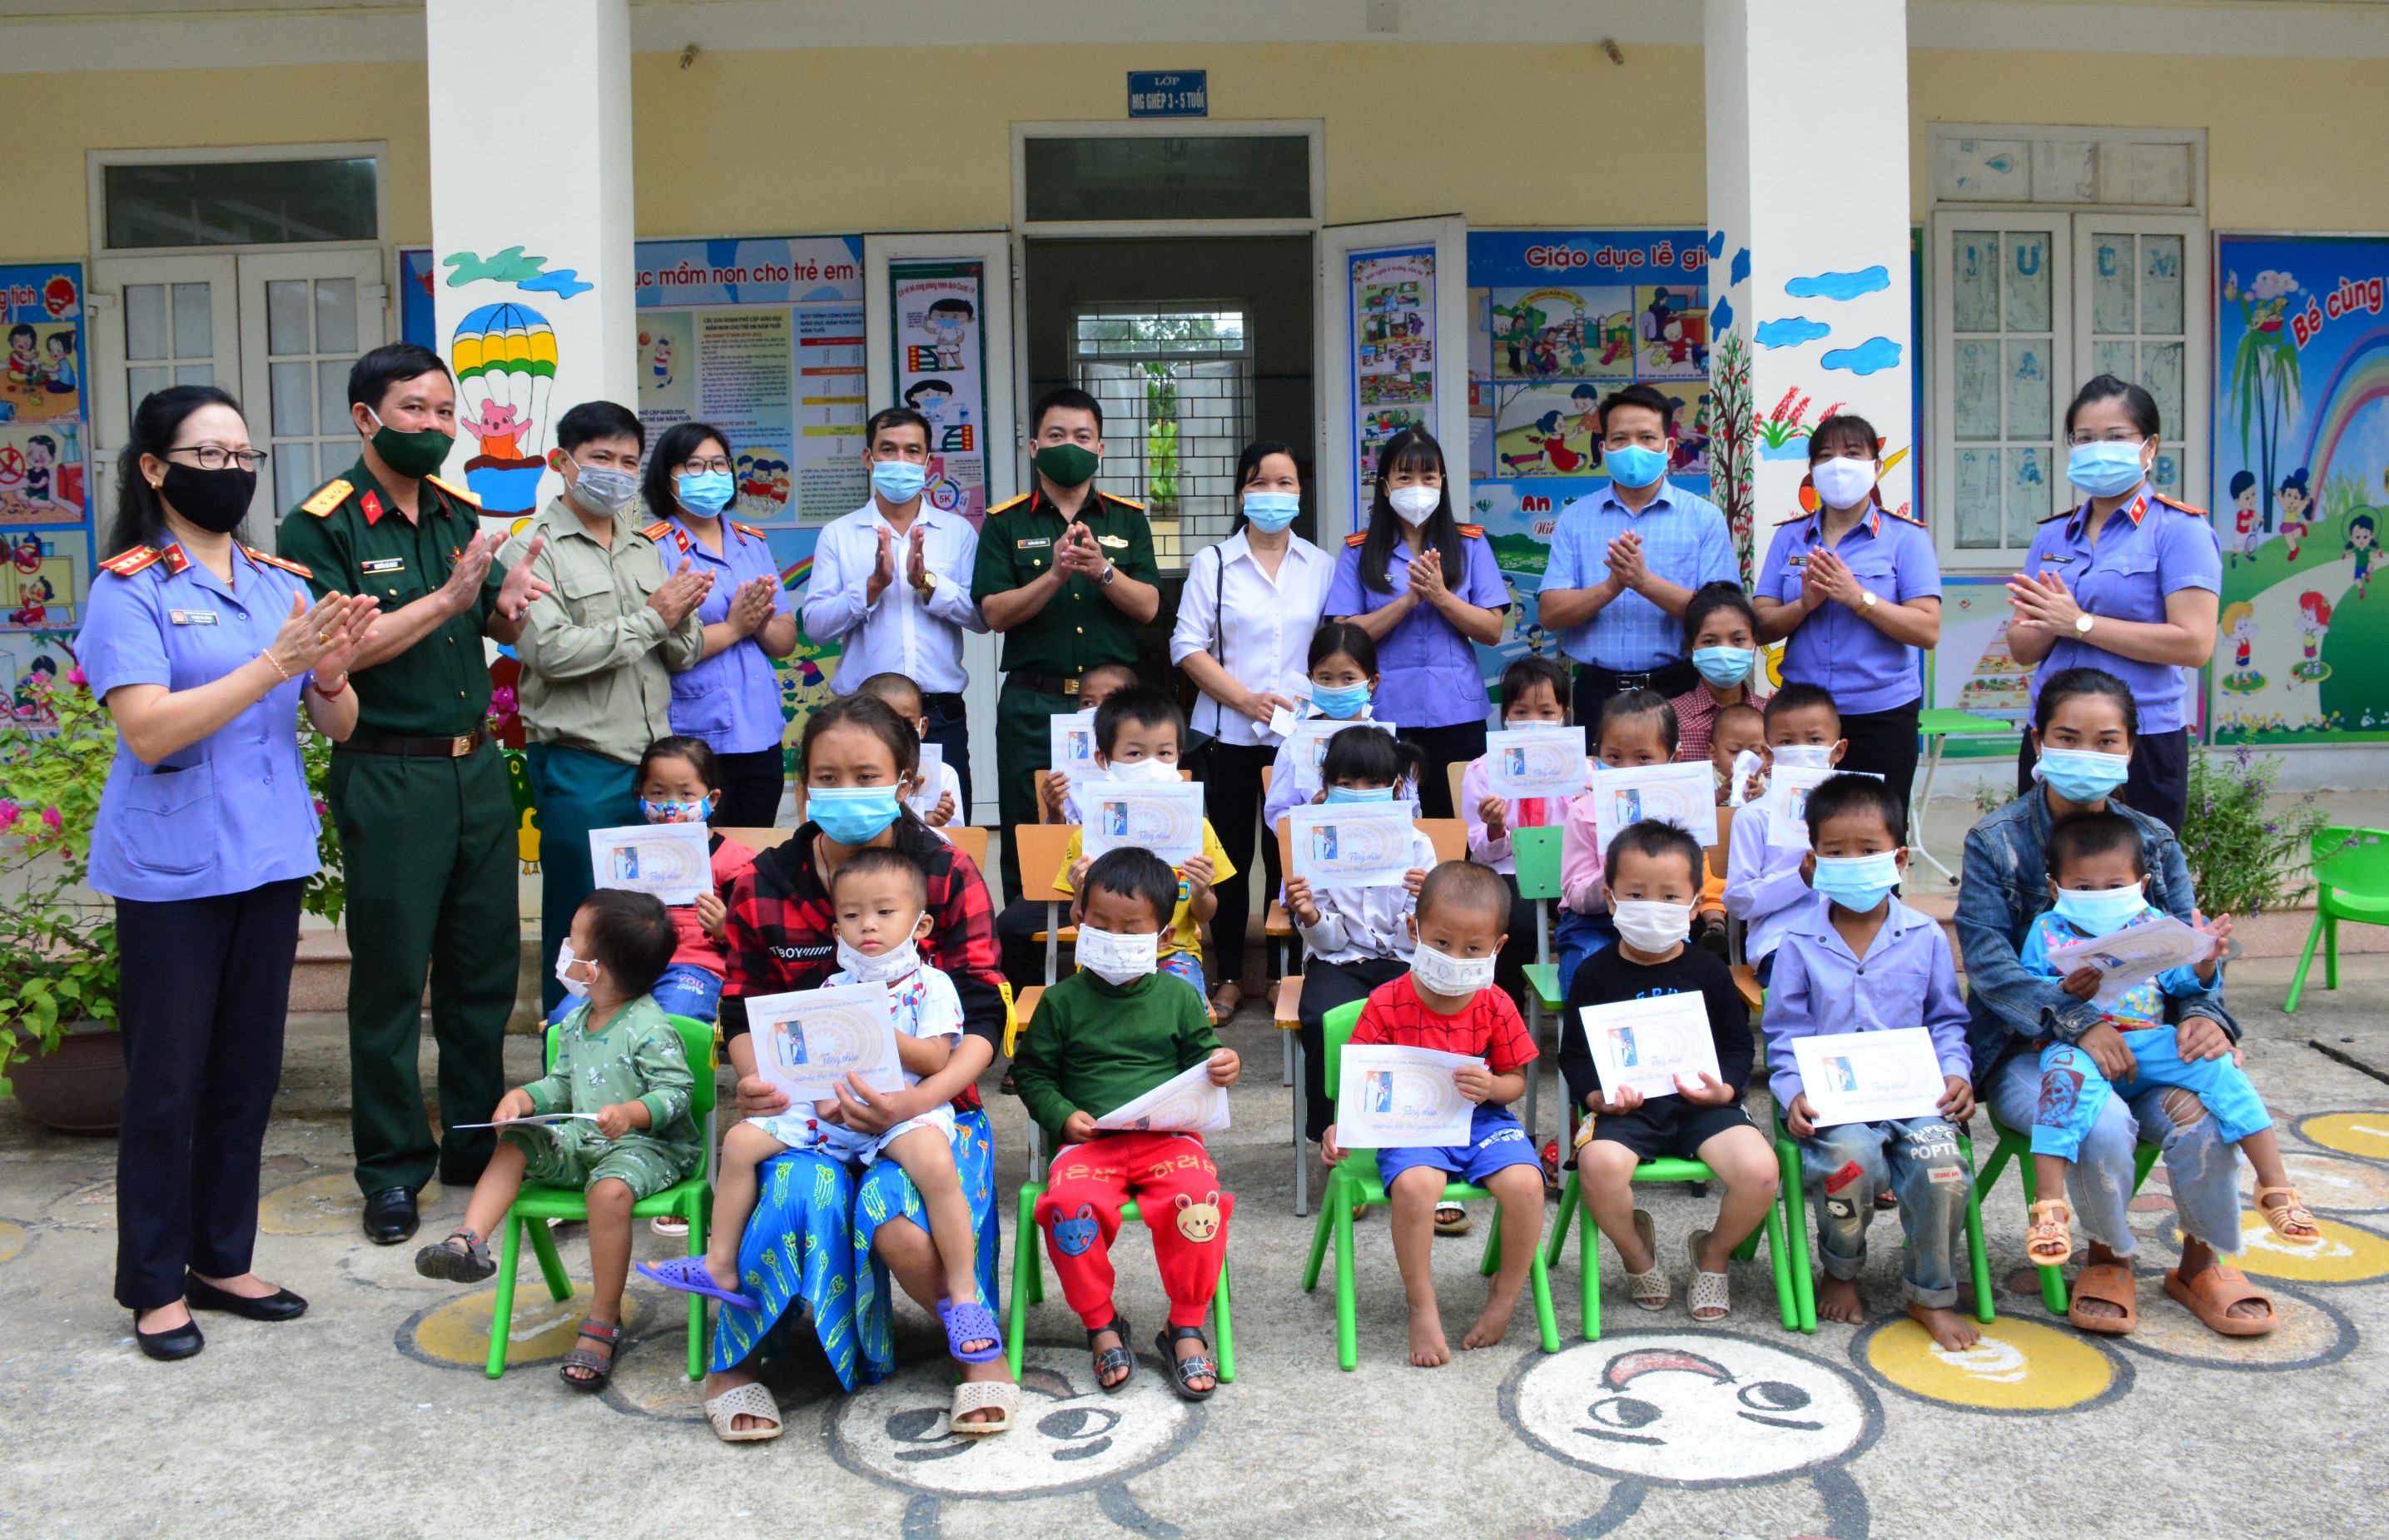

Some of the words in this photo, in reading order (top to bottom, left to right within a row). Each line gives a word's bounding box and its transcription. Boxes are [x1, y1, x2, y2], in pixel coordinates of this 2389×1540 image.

[1155, 75, 1180, 86] LỚP
[1133, 93, 1145, 110] MG
[1146, 89, 1166, 110] GHÉP
[1168, 92, 1174, 109] 3
[1180, 92, 1185, 109] 5
[1186, 85, 1204, 109] TUỔI
[1526, 245, 1588, 267] Giáo
[1594, 246, 1645, 271] dục
[1651, 240, 1673, 266] lễ
[659, 262, 707, 285] mầm
[713, 266, 747, 283] non
[752, 263, 789, 281] cho
[794, 259, 818, 280] trẻ
[824, 265, 853, 279] em
[2292, 296, 2322, 350] Bé
[2327, 278, 2382, 317] cùng
[939, 494, 951, 503] 5K
[1522, 494, 1551, 511] An
